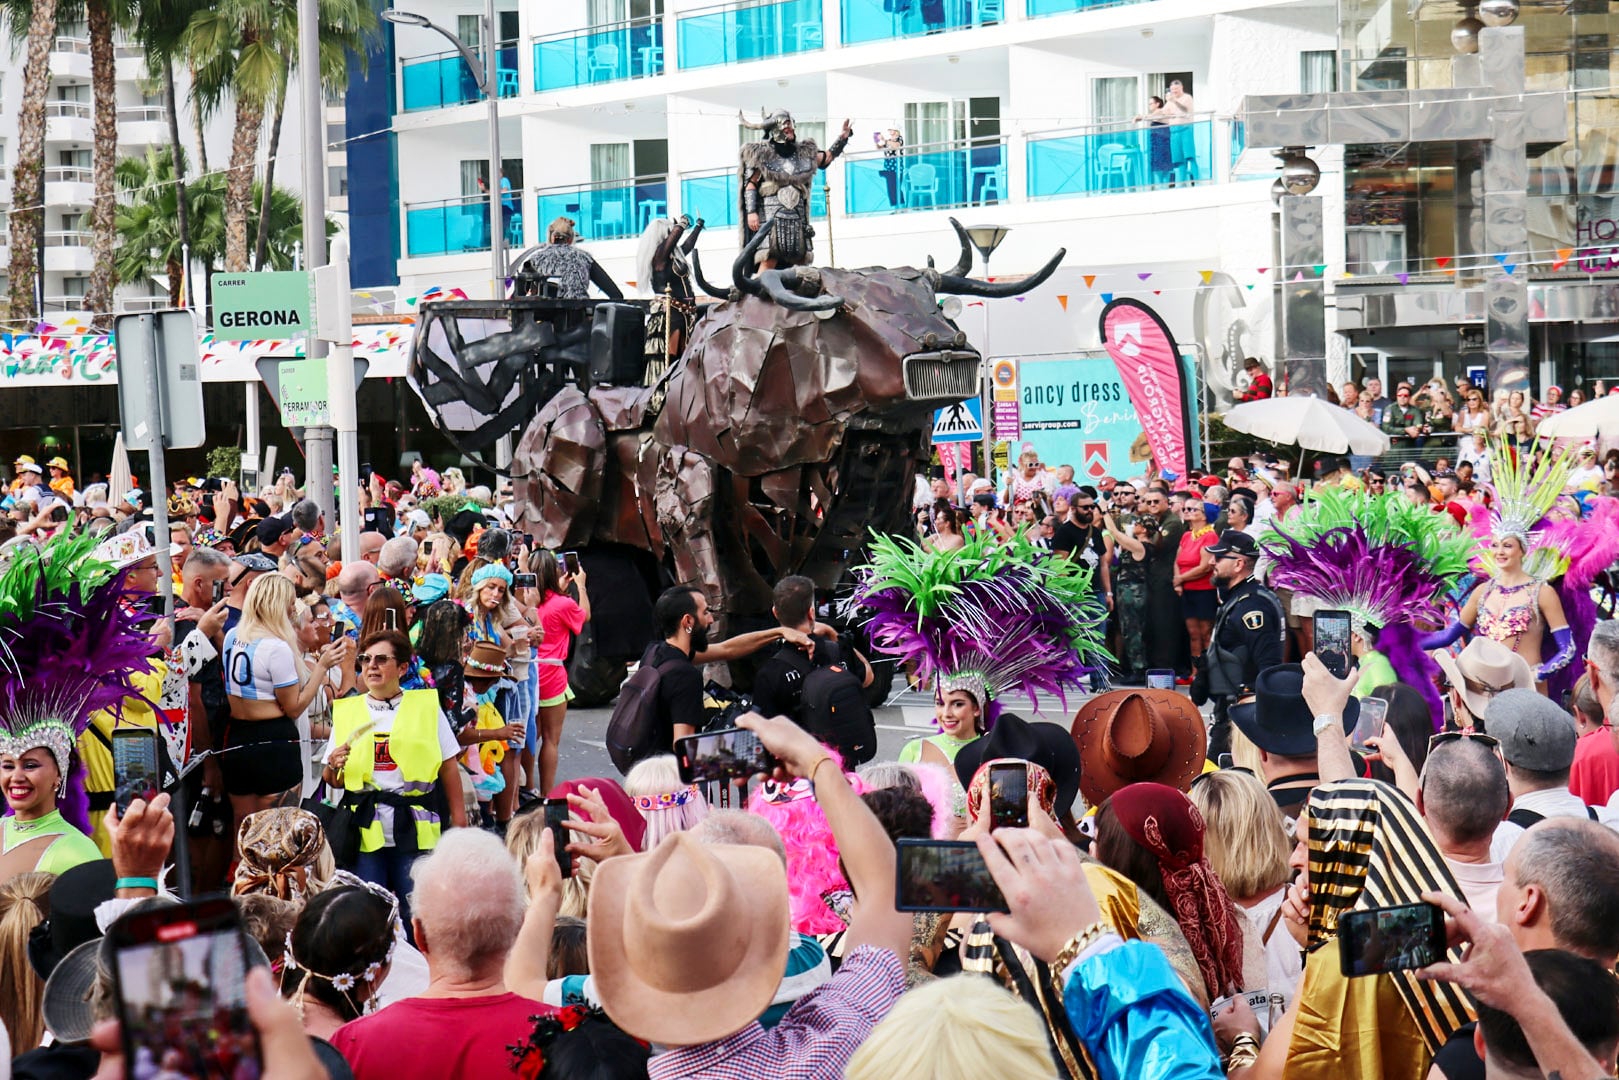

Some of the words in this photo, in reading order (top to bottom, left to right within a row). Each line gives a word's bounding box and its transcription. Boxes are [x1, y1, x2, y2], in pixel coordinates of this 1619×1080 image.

[1576, 219, 1617, 240] HO
[218, 279, 246, 287] CARRER
[220, 309, 300, 328] GERONA
[1024, 385, 1064, 406] ancy
[1071, 381, 1120, 402] dress
[1022, 420, 1079, 431] .servigroup.com
[225, 648, 252, 687] 10
[1249, 995, 1266, 1006] ata
